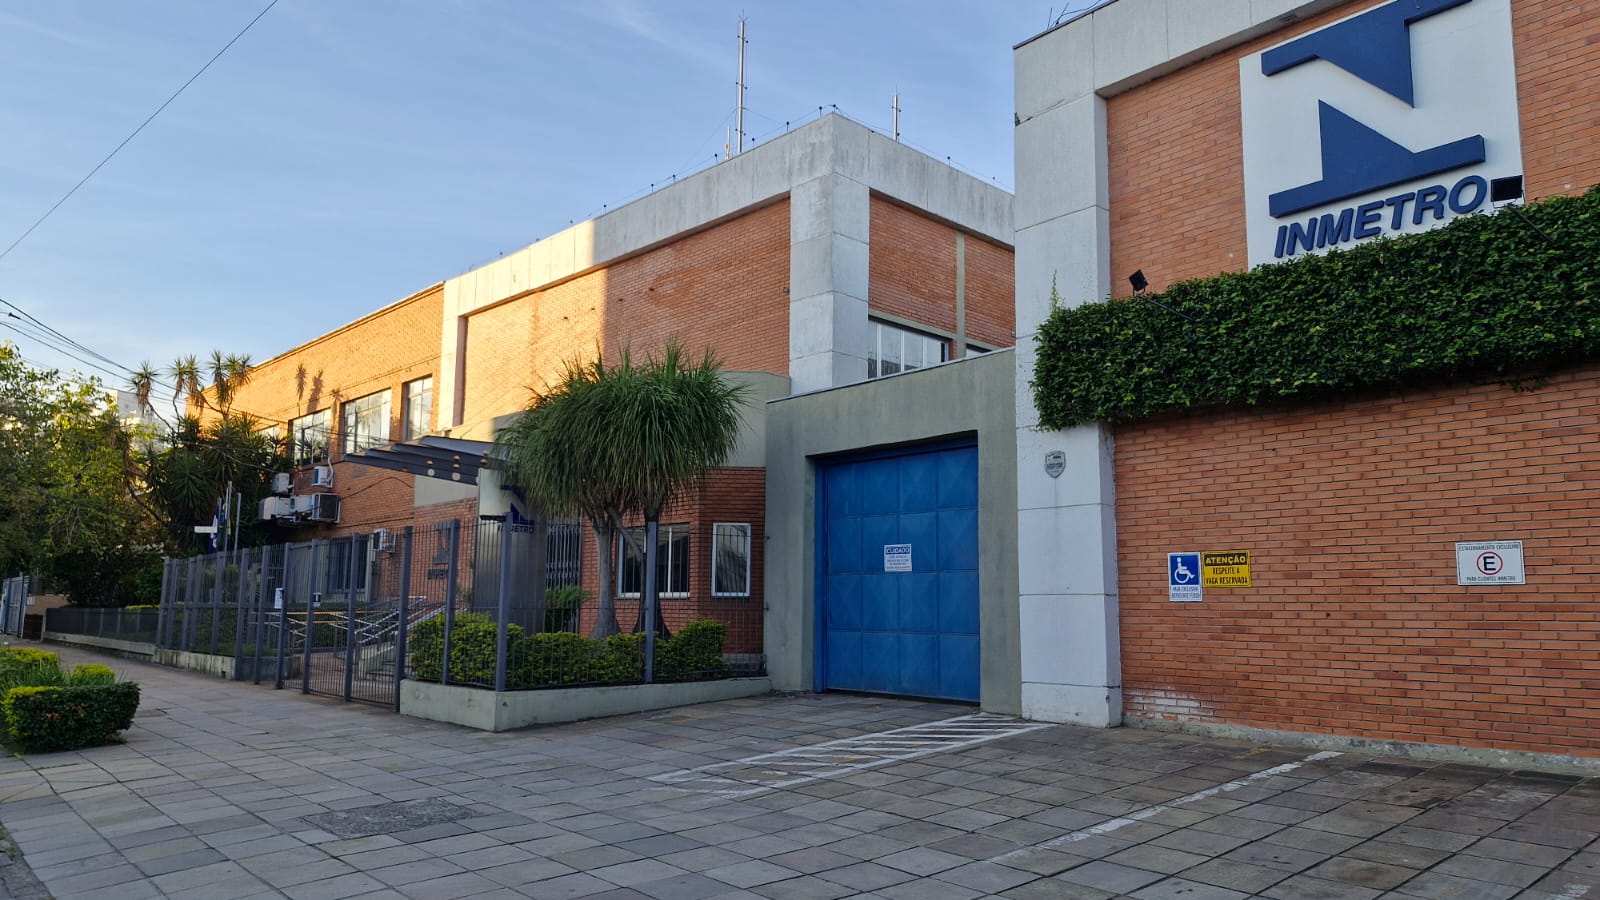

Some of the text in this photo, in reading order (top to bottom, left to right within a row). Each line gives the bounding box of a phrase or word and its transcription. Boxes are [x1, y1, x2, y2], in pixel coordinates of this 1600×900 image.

[1274, 175, 1488, 258] INMETRO
[1205, 555, 1246, 565] ATENÇÃO
[1483, 556, 1497, 571] E
[1206, 576, 1248, 585] VAGA RESERVADA
